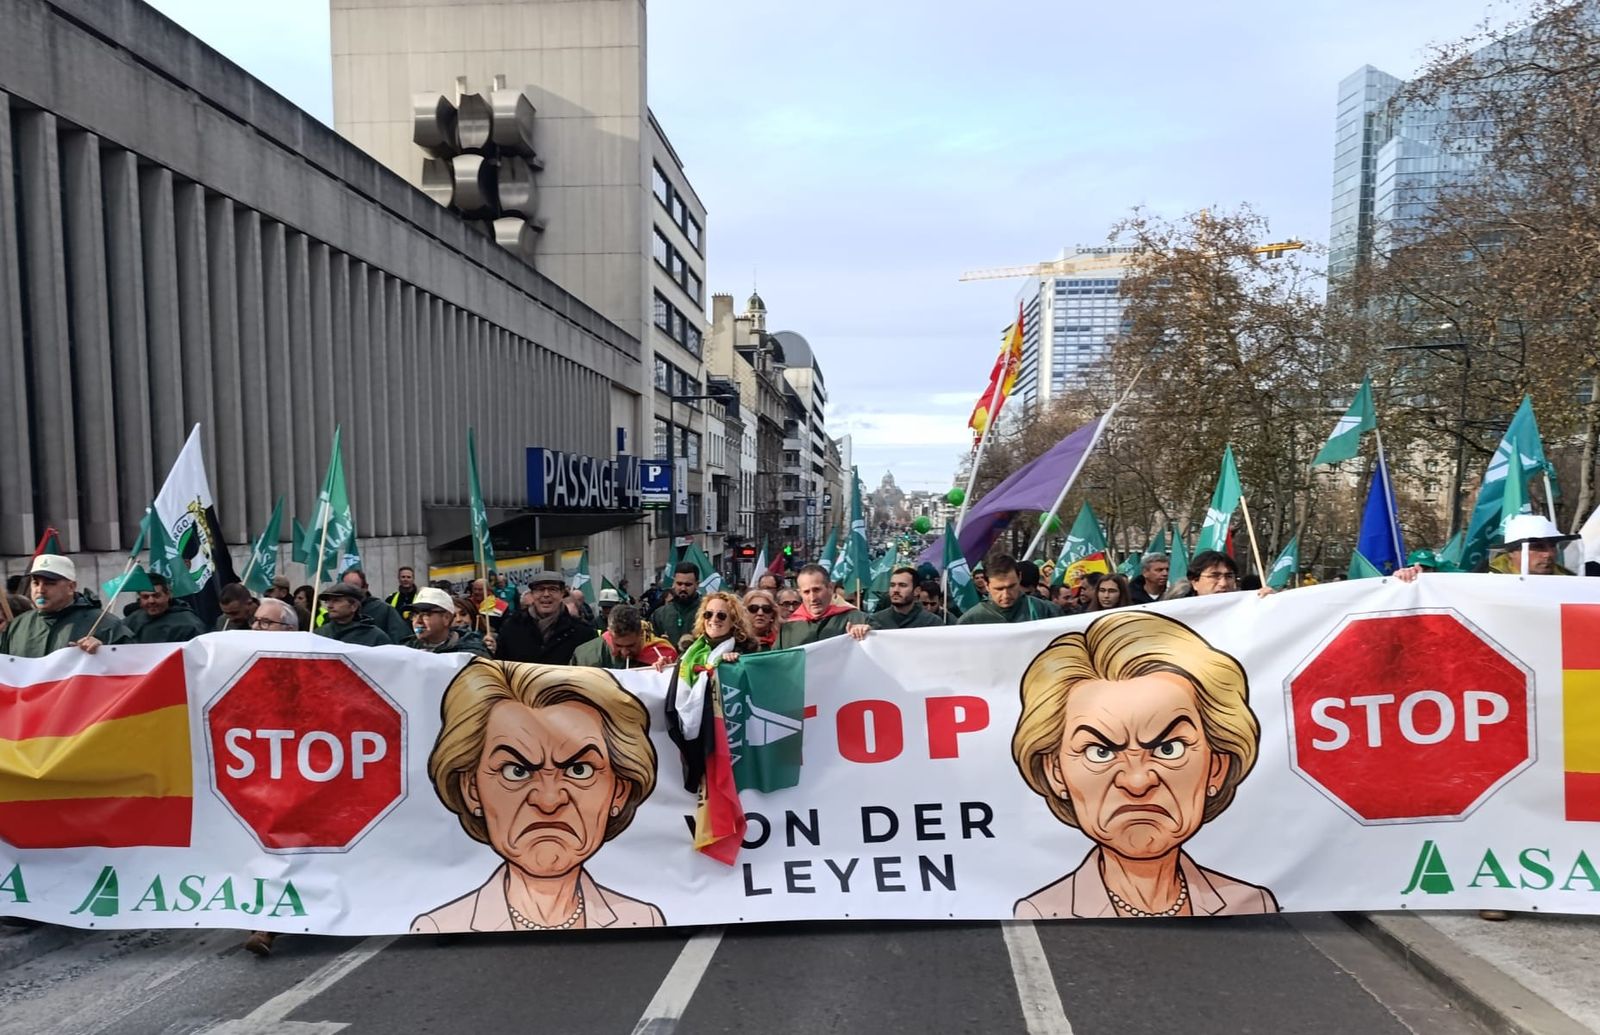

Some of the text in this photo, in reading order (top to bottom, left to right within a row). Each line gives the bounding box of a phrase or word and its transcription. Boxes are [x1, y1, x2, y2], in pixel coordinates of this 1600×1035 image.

[543, 449, 641, 508] PASSAGE 44
[648, 466, 662, 482] P
[802, 695, 989, 764] OP
[1311, 690, 1509, 751] STOP
[224, 728, 387, 782] STOP
[861, 802, 996, 844] DER
[131, 874, 309, 918] ASAJA
[742, 854, 957, 897] LEYEN
